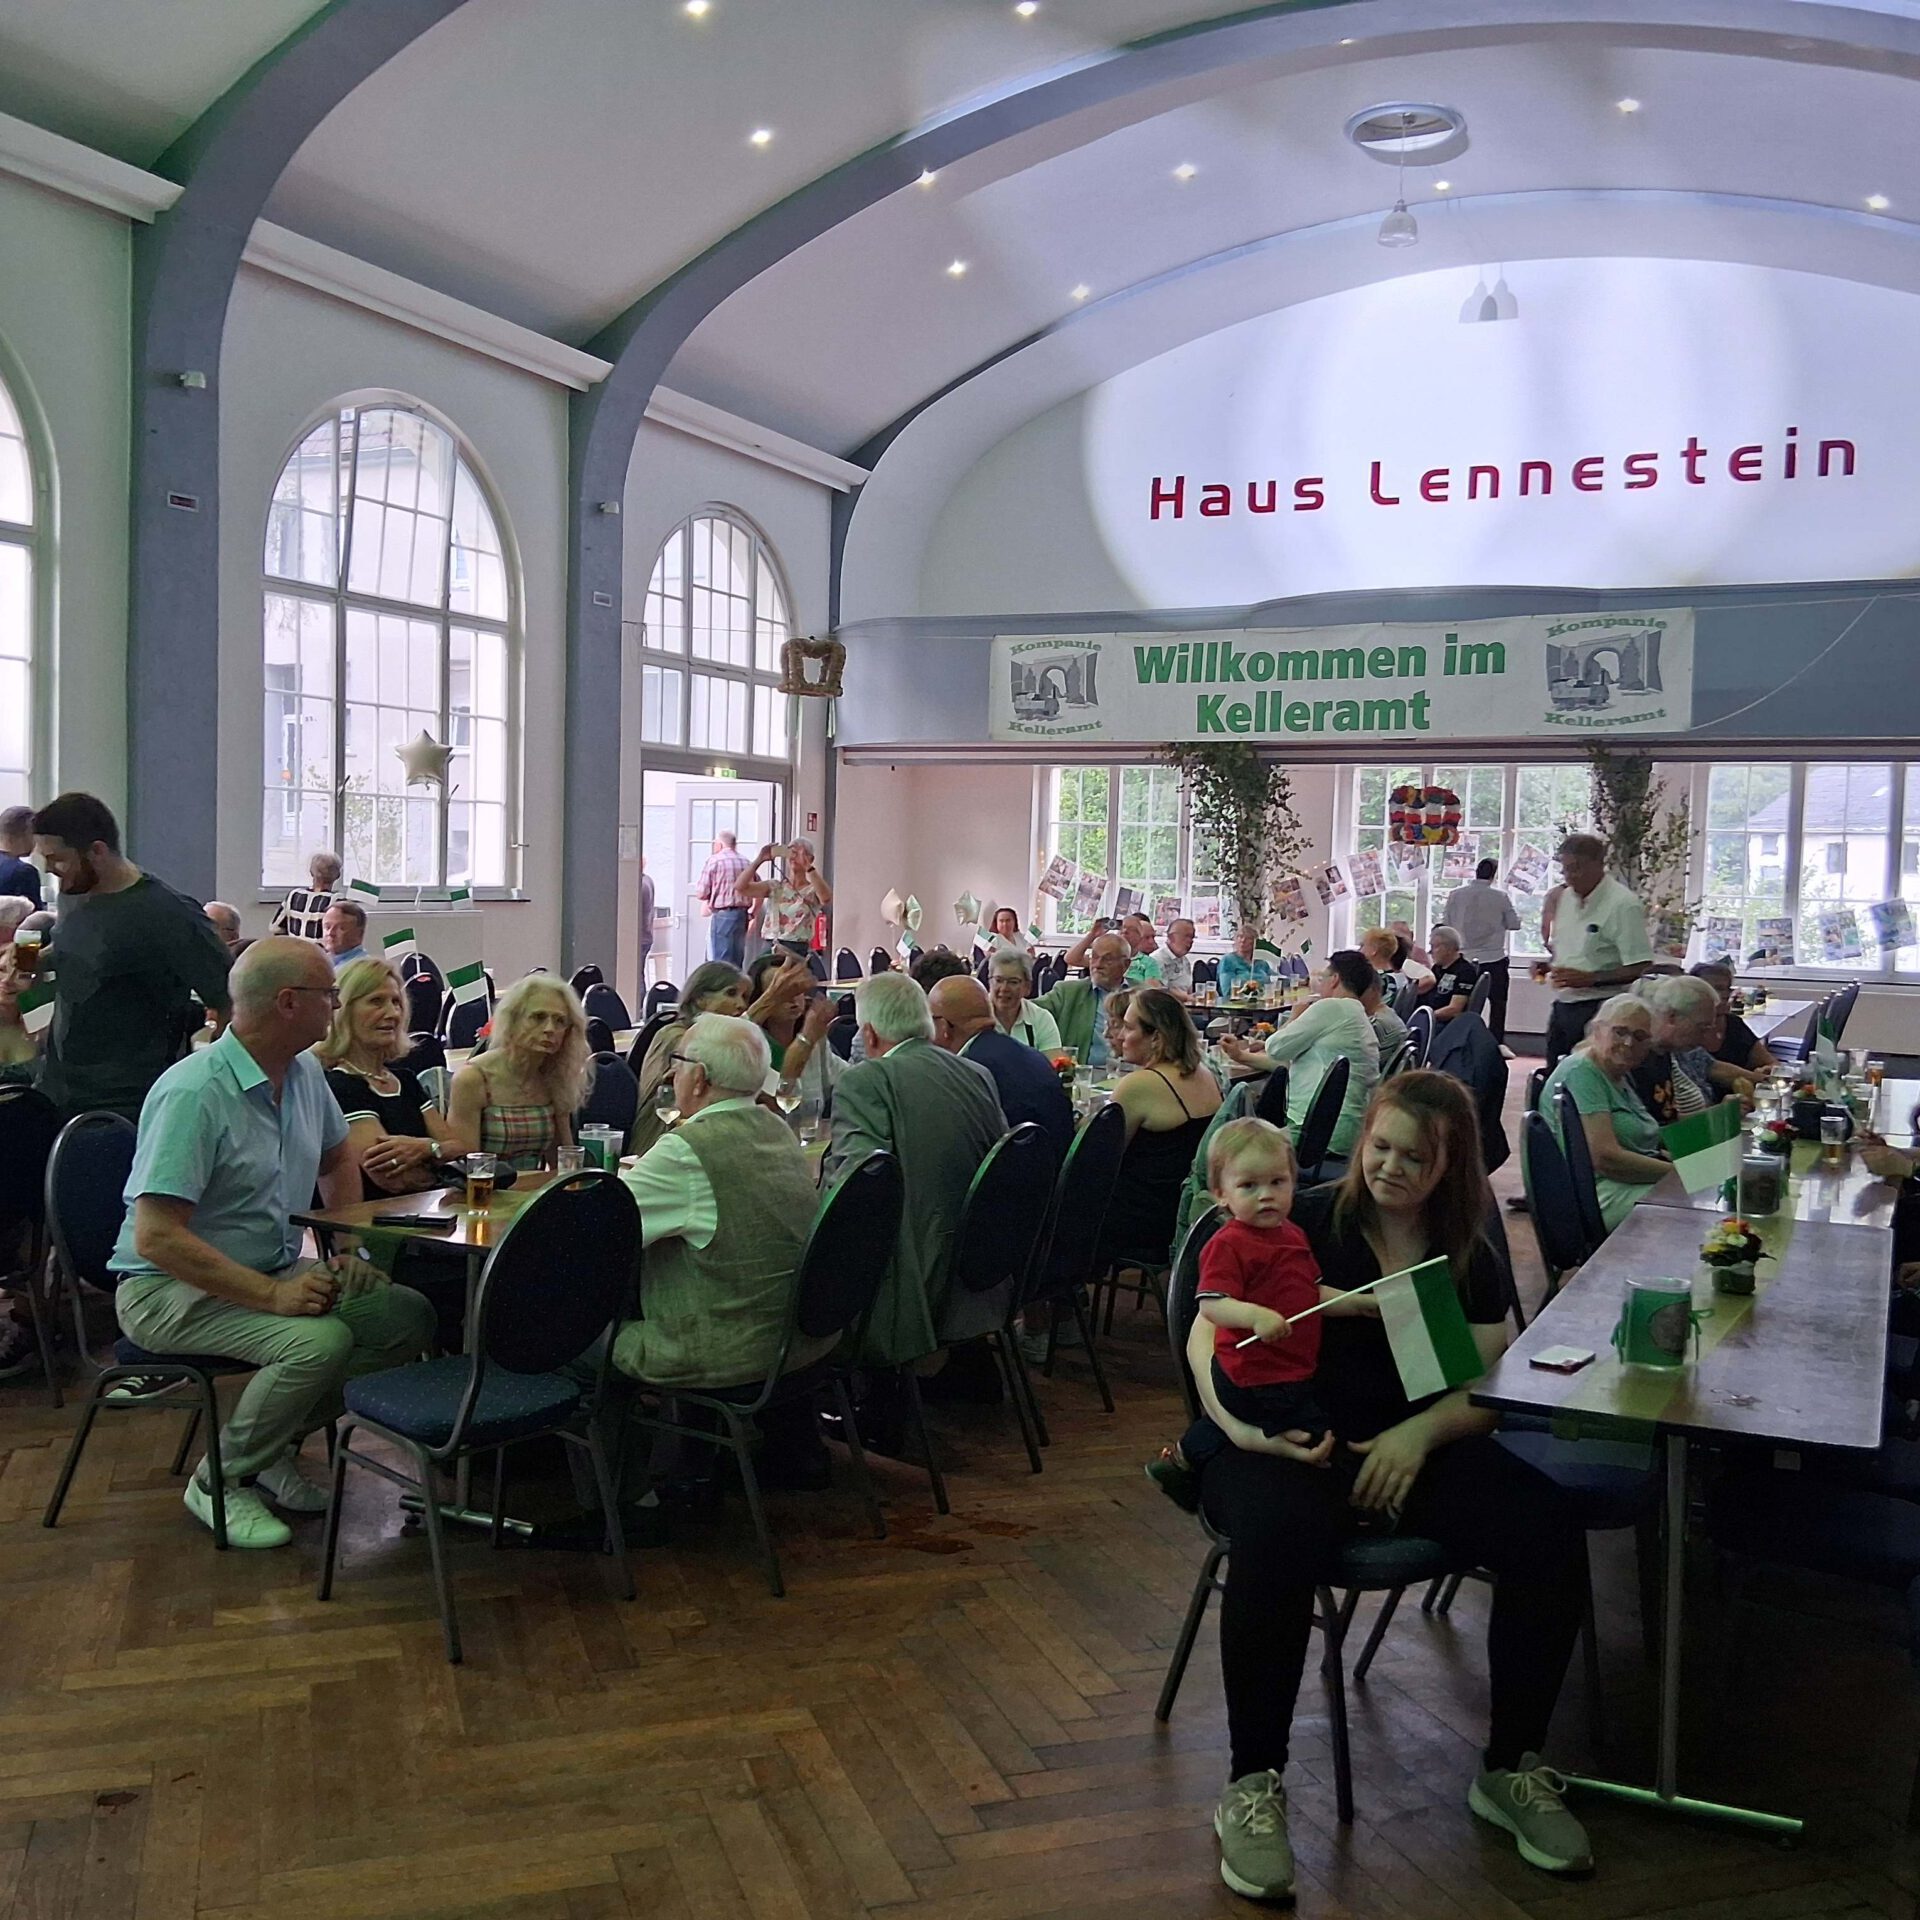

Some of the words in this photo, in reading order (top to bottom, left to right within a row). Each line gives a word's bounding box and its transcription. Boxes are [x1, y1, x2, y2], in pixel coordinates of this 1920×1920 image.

[1150, 475, 1325, 521] Haus
[1369, 426, 1857, 506] Lennestein
[1545, 617, 1667, 638] Kompanie
[1009, 639, 1102, 656] Kompanie
[1133, 641, 1427, 684] Willkommen
[1443, 633, 1506, 677] im
[1196, 690, 1431, 734] Kelleramt
[1544, 708, 1666, 728] Kelleramt
[1007, 720, 1103, 735] Kelleramt
